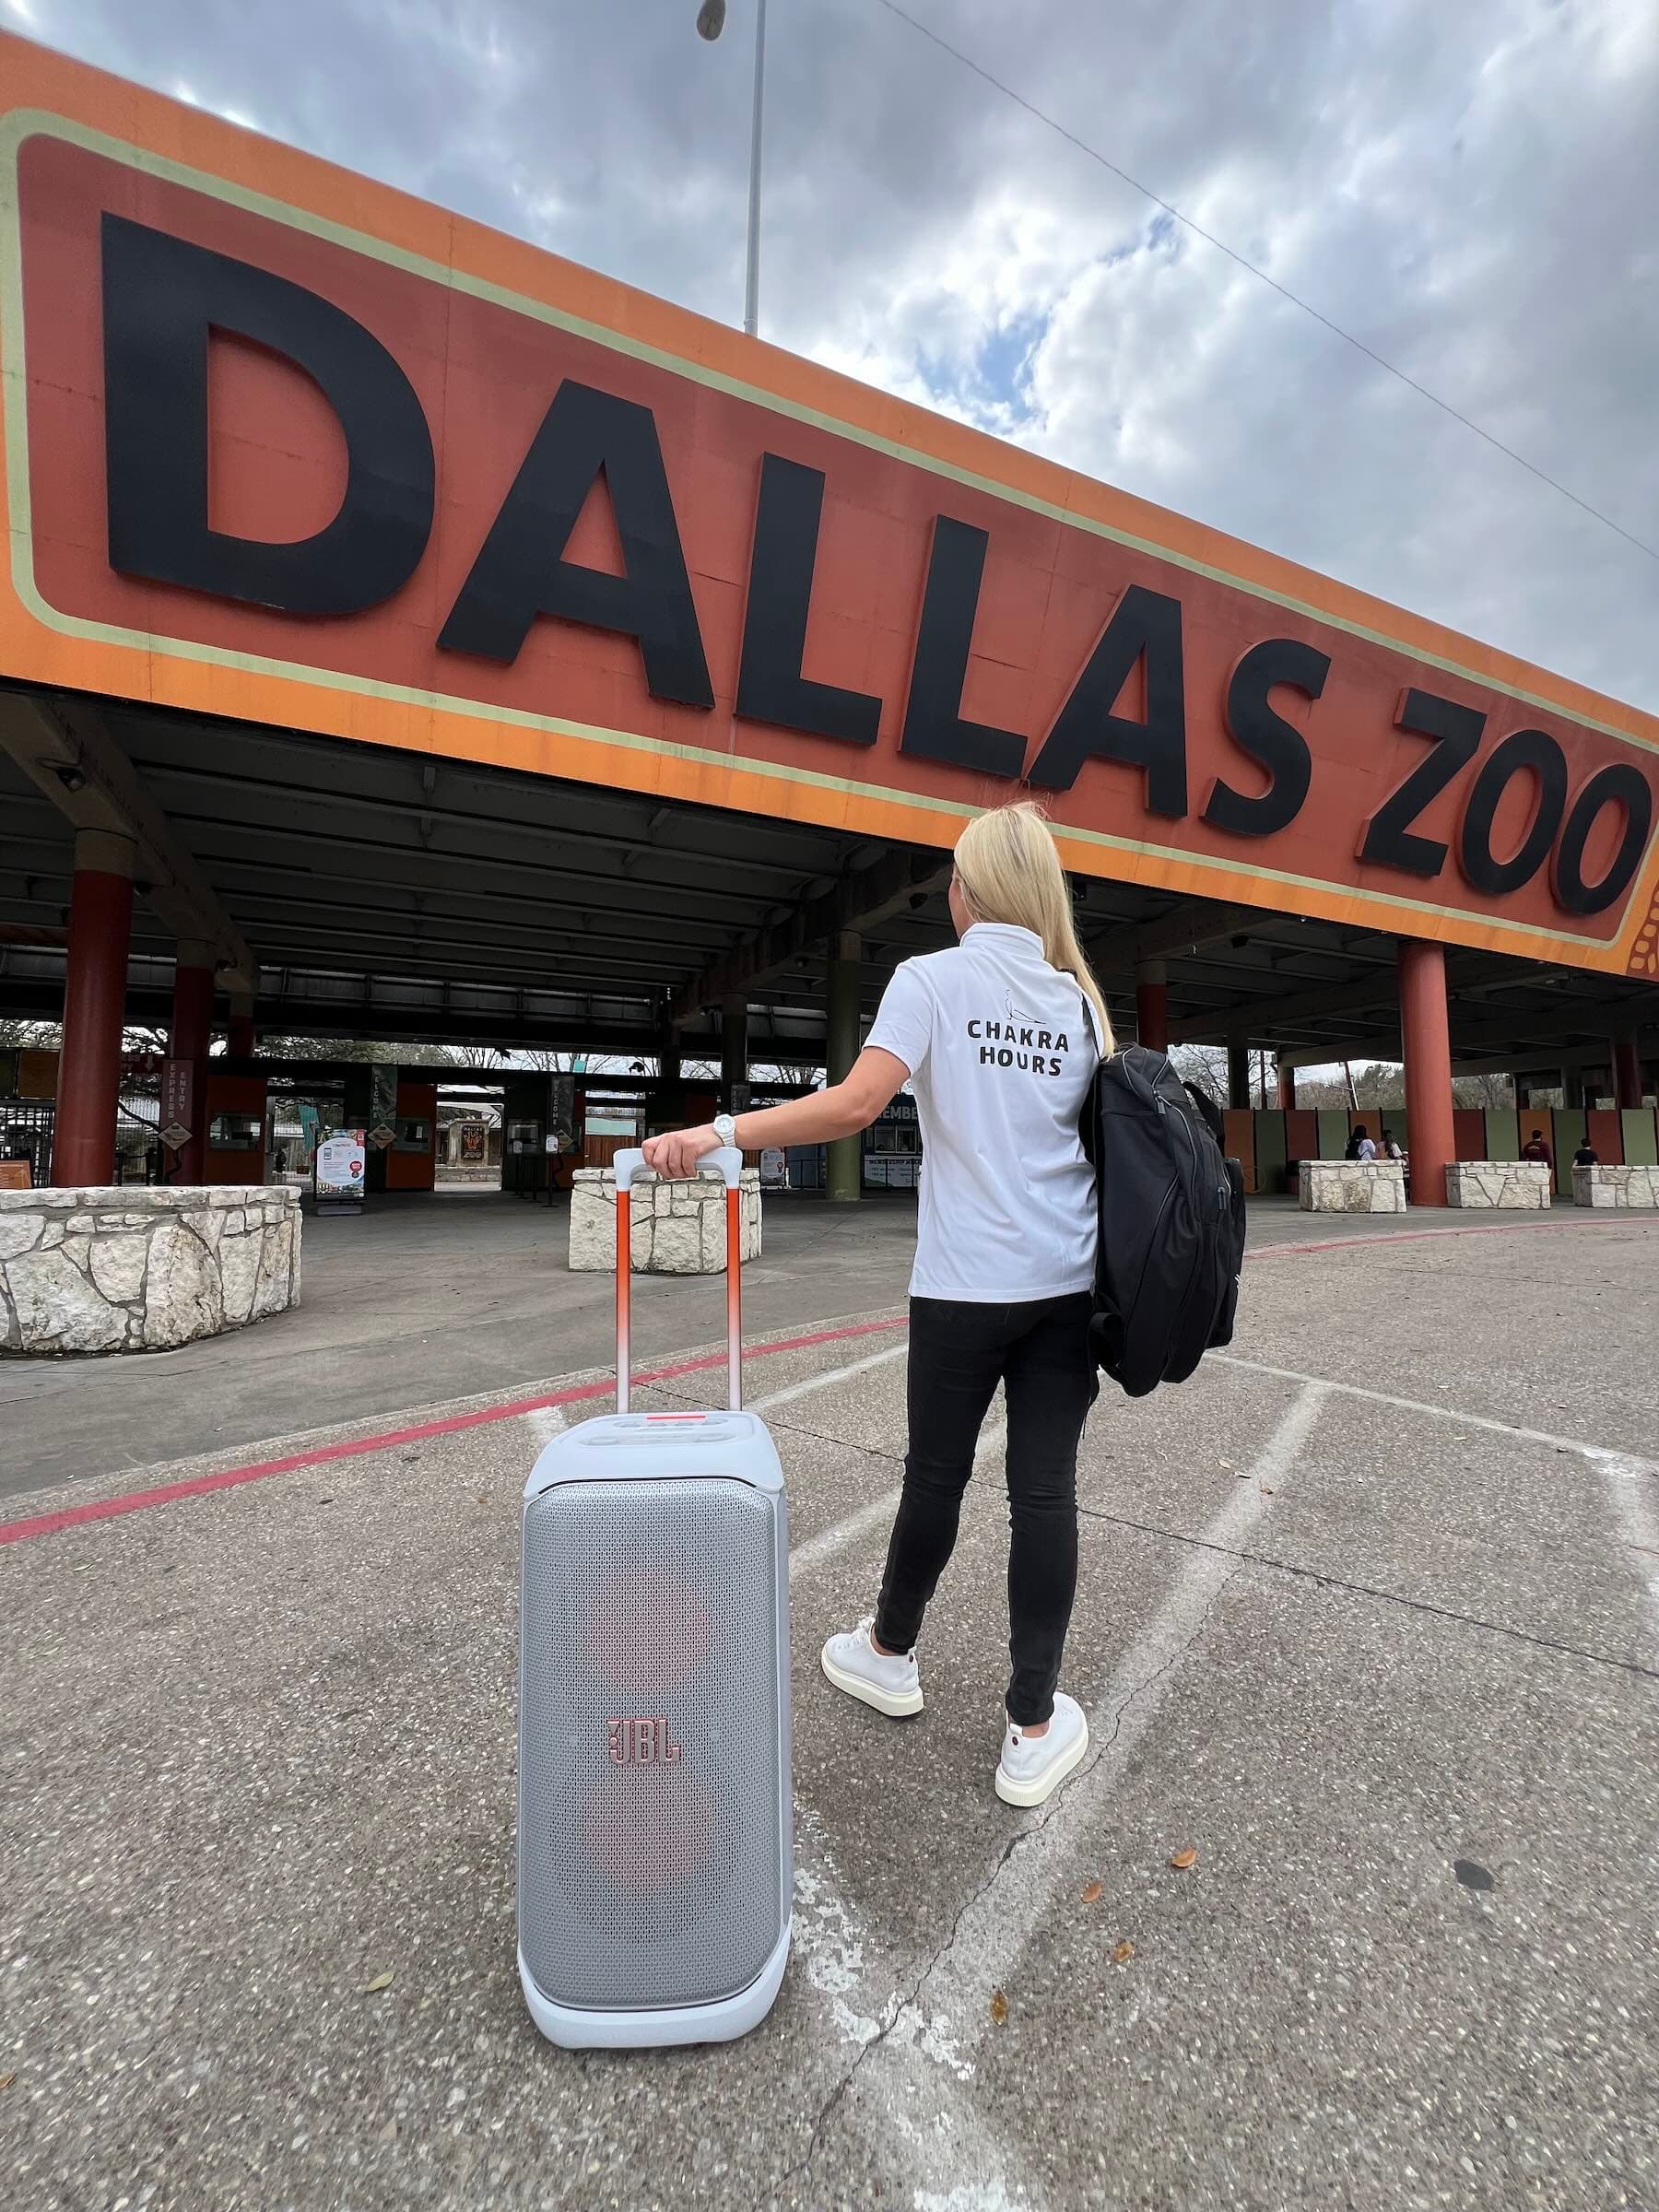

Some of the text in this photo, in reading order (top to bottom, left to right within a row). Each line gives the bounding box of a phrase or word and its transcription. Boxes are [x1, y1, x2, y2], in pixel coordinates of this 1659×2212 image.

[101, 211, 1653, 915] DALLAS ZOO
[968, 1019, 1069, 1053] CHAKRA
[980, 1046, 1062, 1077] HOURS
[168, 1063, 177, 1119] EXPRESS
[179, 1071, 187, 1111] ENTRY
[607, 1718, 681, 1764] JBL
